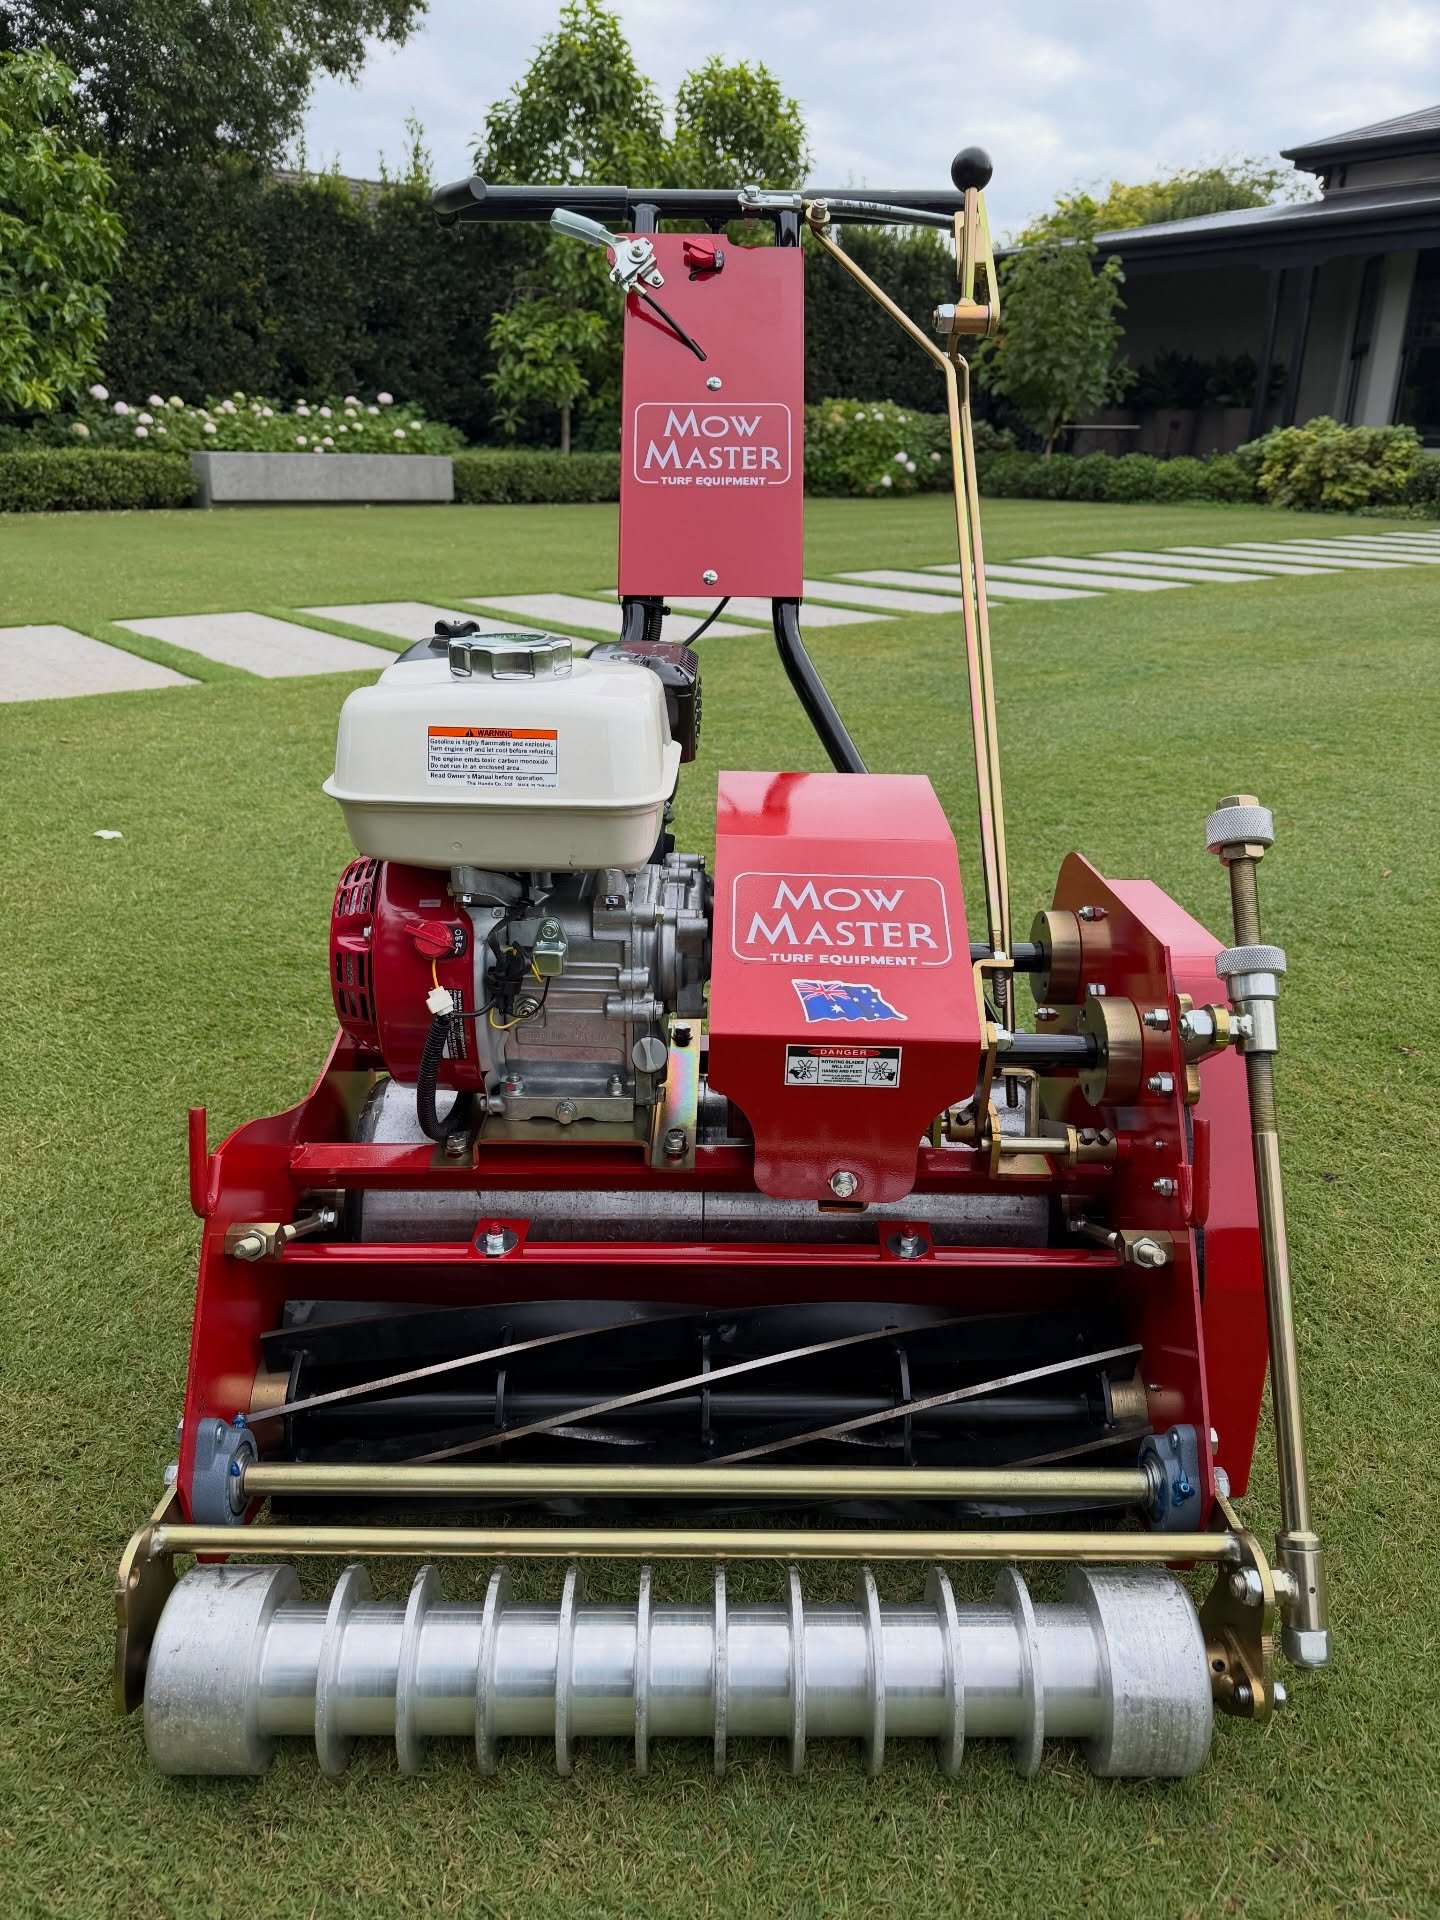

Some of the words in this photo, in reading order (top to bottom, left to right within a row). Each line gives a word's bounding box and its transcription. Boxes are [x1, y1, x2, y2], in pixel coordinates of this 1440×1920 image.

[643, 439, 782, 470] MASTER
[660, 476, 692, 485] TURF
[696, 476, 766, 486] EQUIPMENT
[745, 912, 939, 948] MASTER
[770, 953, 814, 962] TURF
[819, 955, 918, 966] EQUIPMENT
